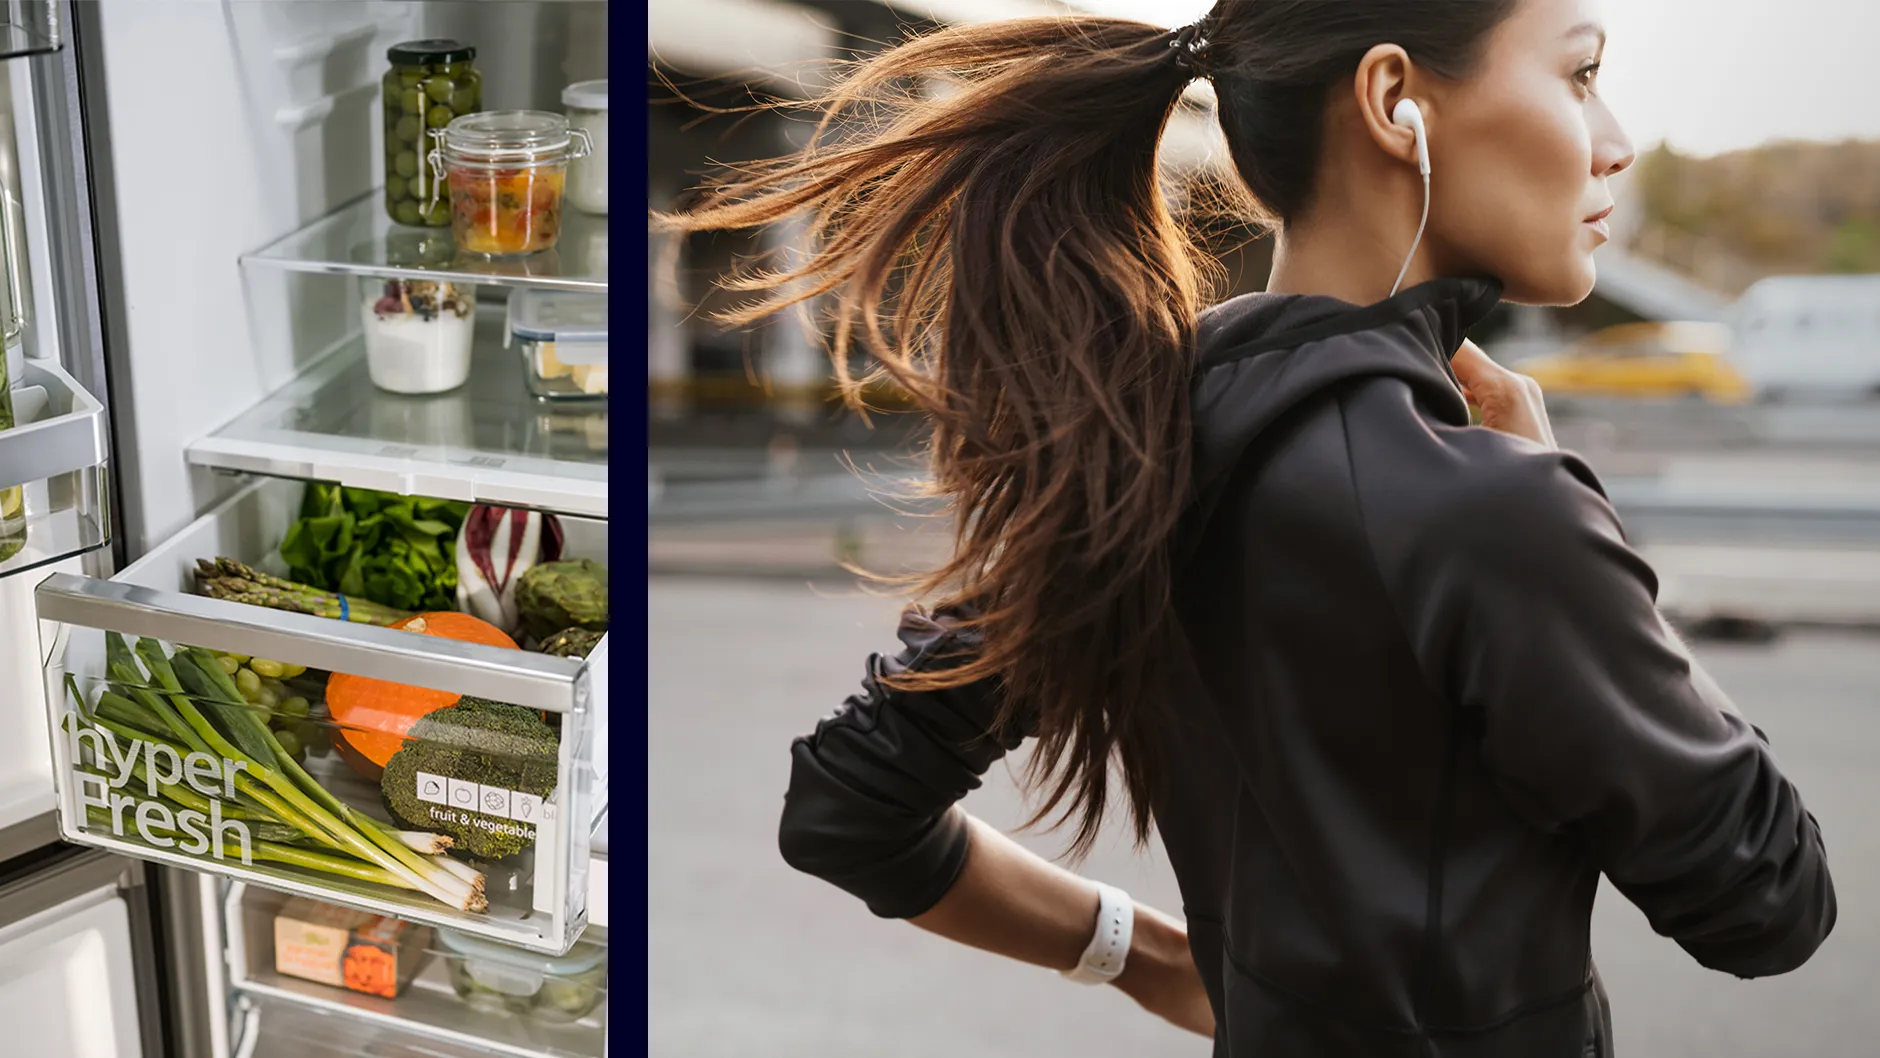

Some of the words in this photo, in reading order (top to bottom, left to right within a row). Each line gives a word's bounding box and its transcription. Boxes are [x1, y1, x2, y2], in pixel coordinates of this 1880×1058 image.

[66, 711, 247, 798] hyper
[73, 770, 252, 866] Fresh
[429, 807, 456, 823] fruit
[460, 813, 470, 826] &
